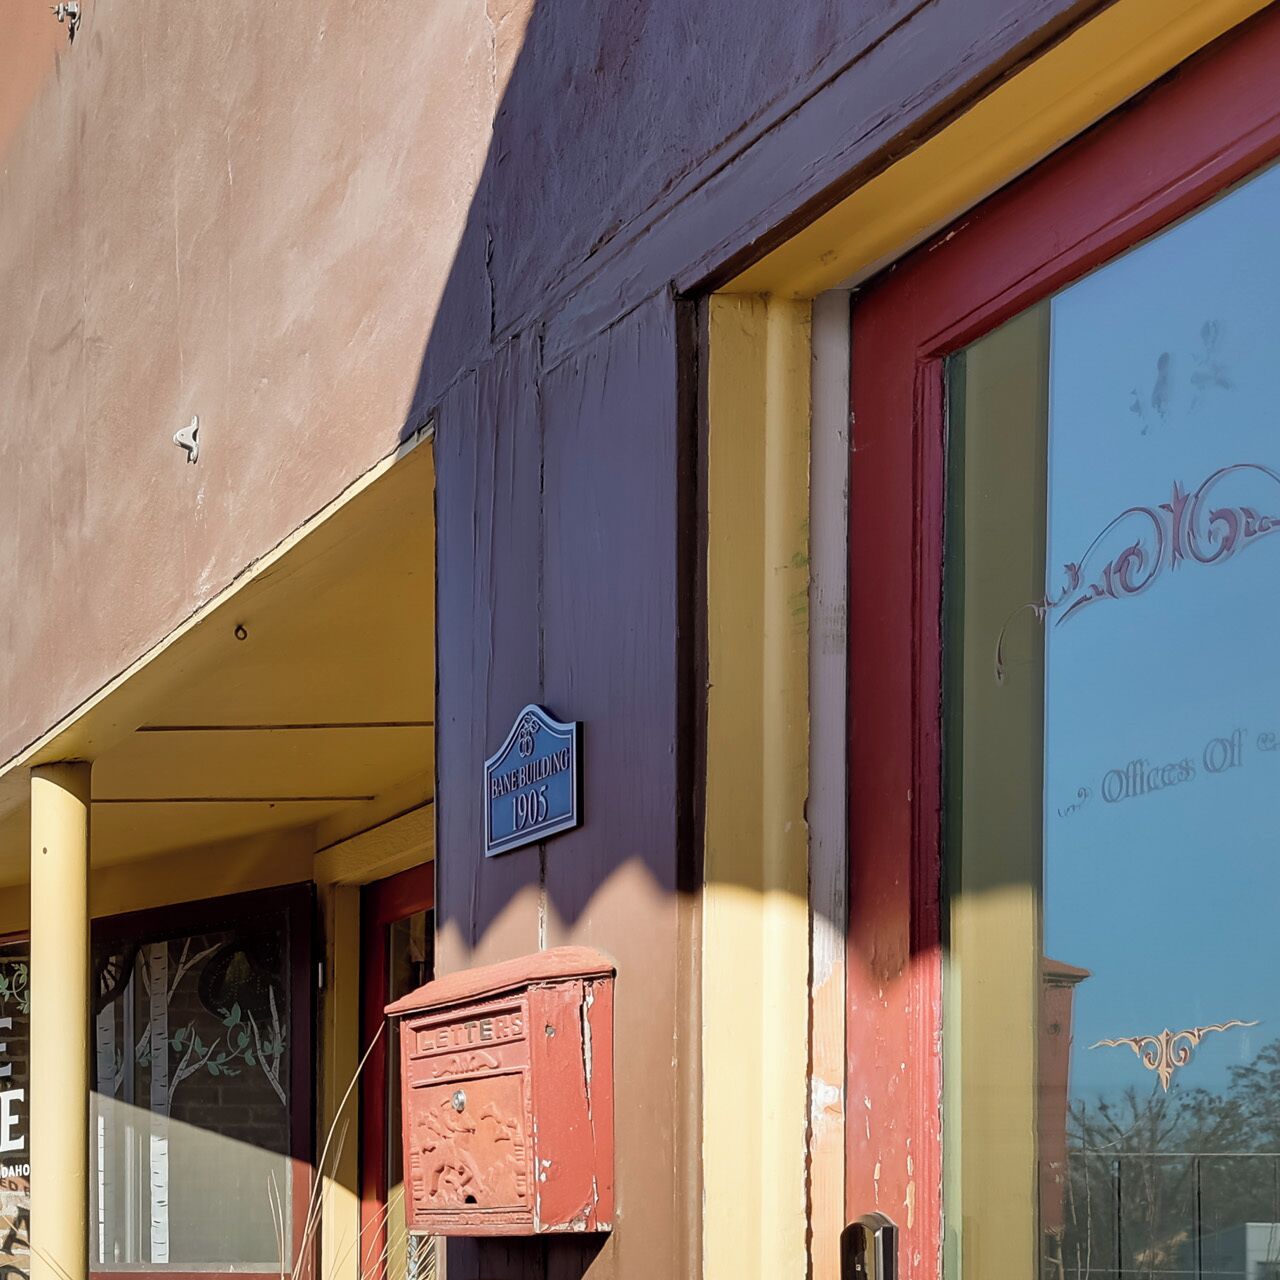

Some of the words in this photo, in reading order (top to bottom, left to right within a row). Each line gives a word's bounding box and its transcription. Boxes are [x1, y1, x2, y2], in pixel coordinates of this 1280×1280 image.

[491, 771, 519, 799] BANE
[519, 748, 570, 788] BUILDING
[1100, 757, 1195, 804] Offices
[512, 785, 547, 831] 1905
[421, 1017, 522, 1051] LETTERS
